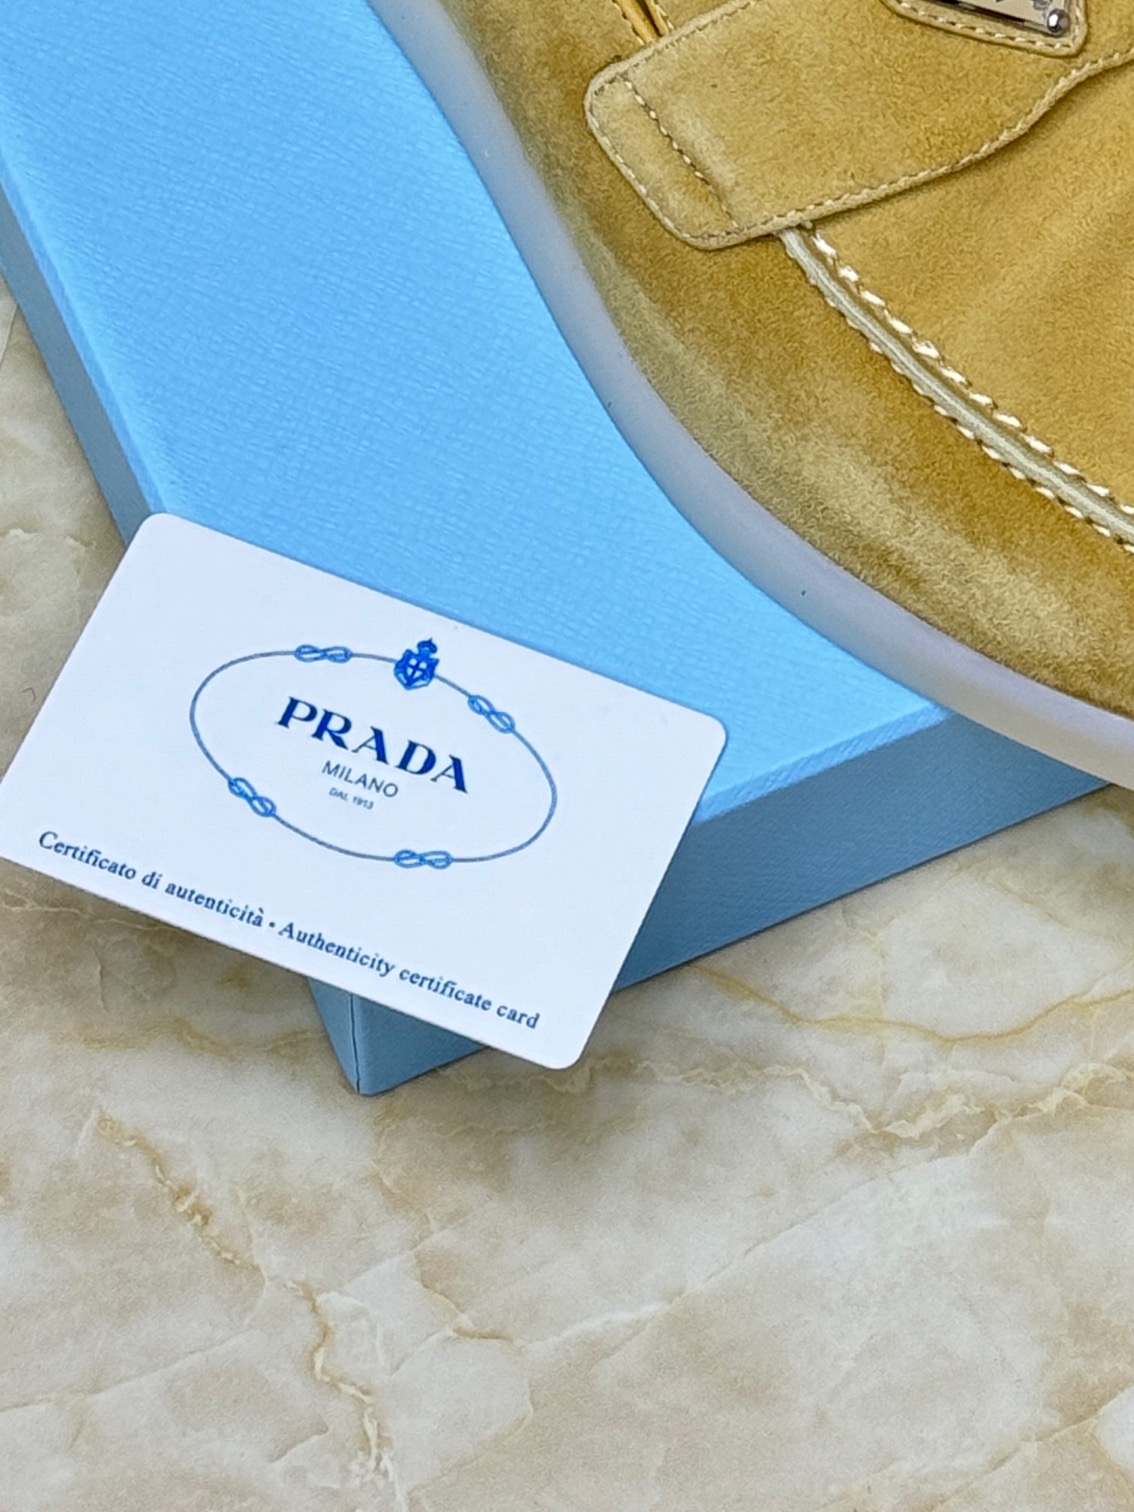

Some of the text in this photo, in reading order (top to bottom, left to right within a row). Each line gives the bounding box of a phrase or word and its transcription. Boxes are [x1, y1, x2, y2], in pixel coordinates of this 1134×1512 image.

[275, 696, 468, 794] PRADA
[321, 760, 399, 798] MILANO
[328, 787, 348, 802] DAL
[38, 830, 541, 1030] Certificato di autenticità Authenticity certificate card
